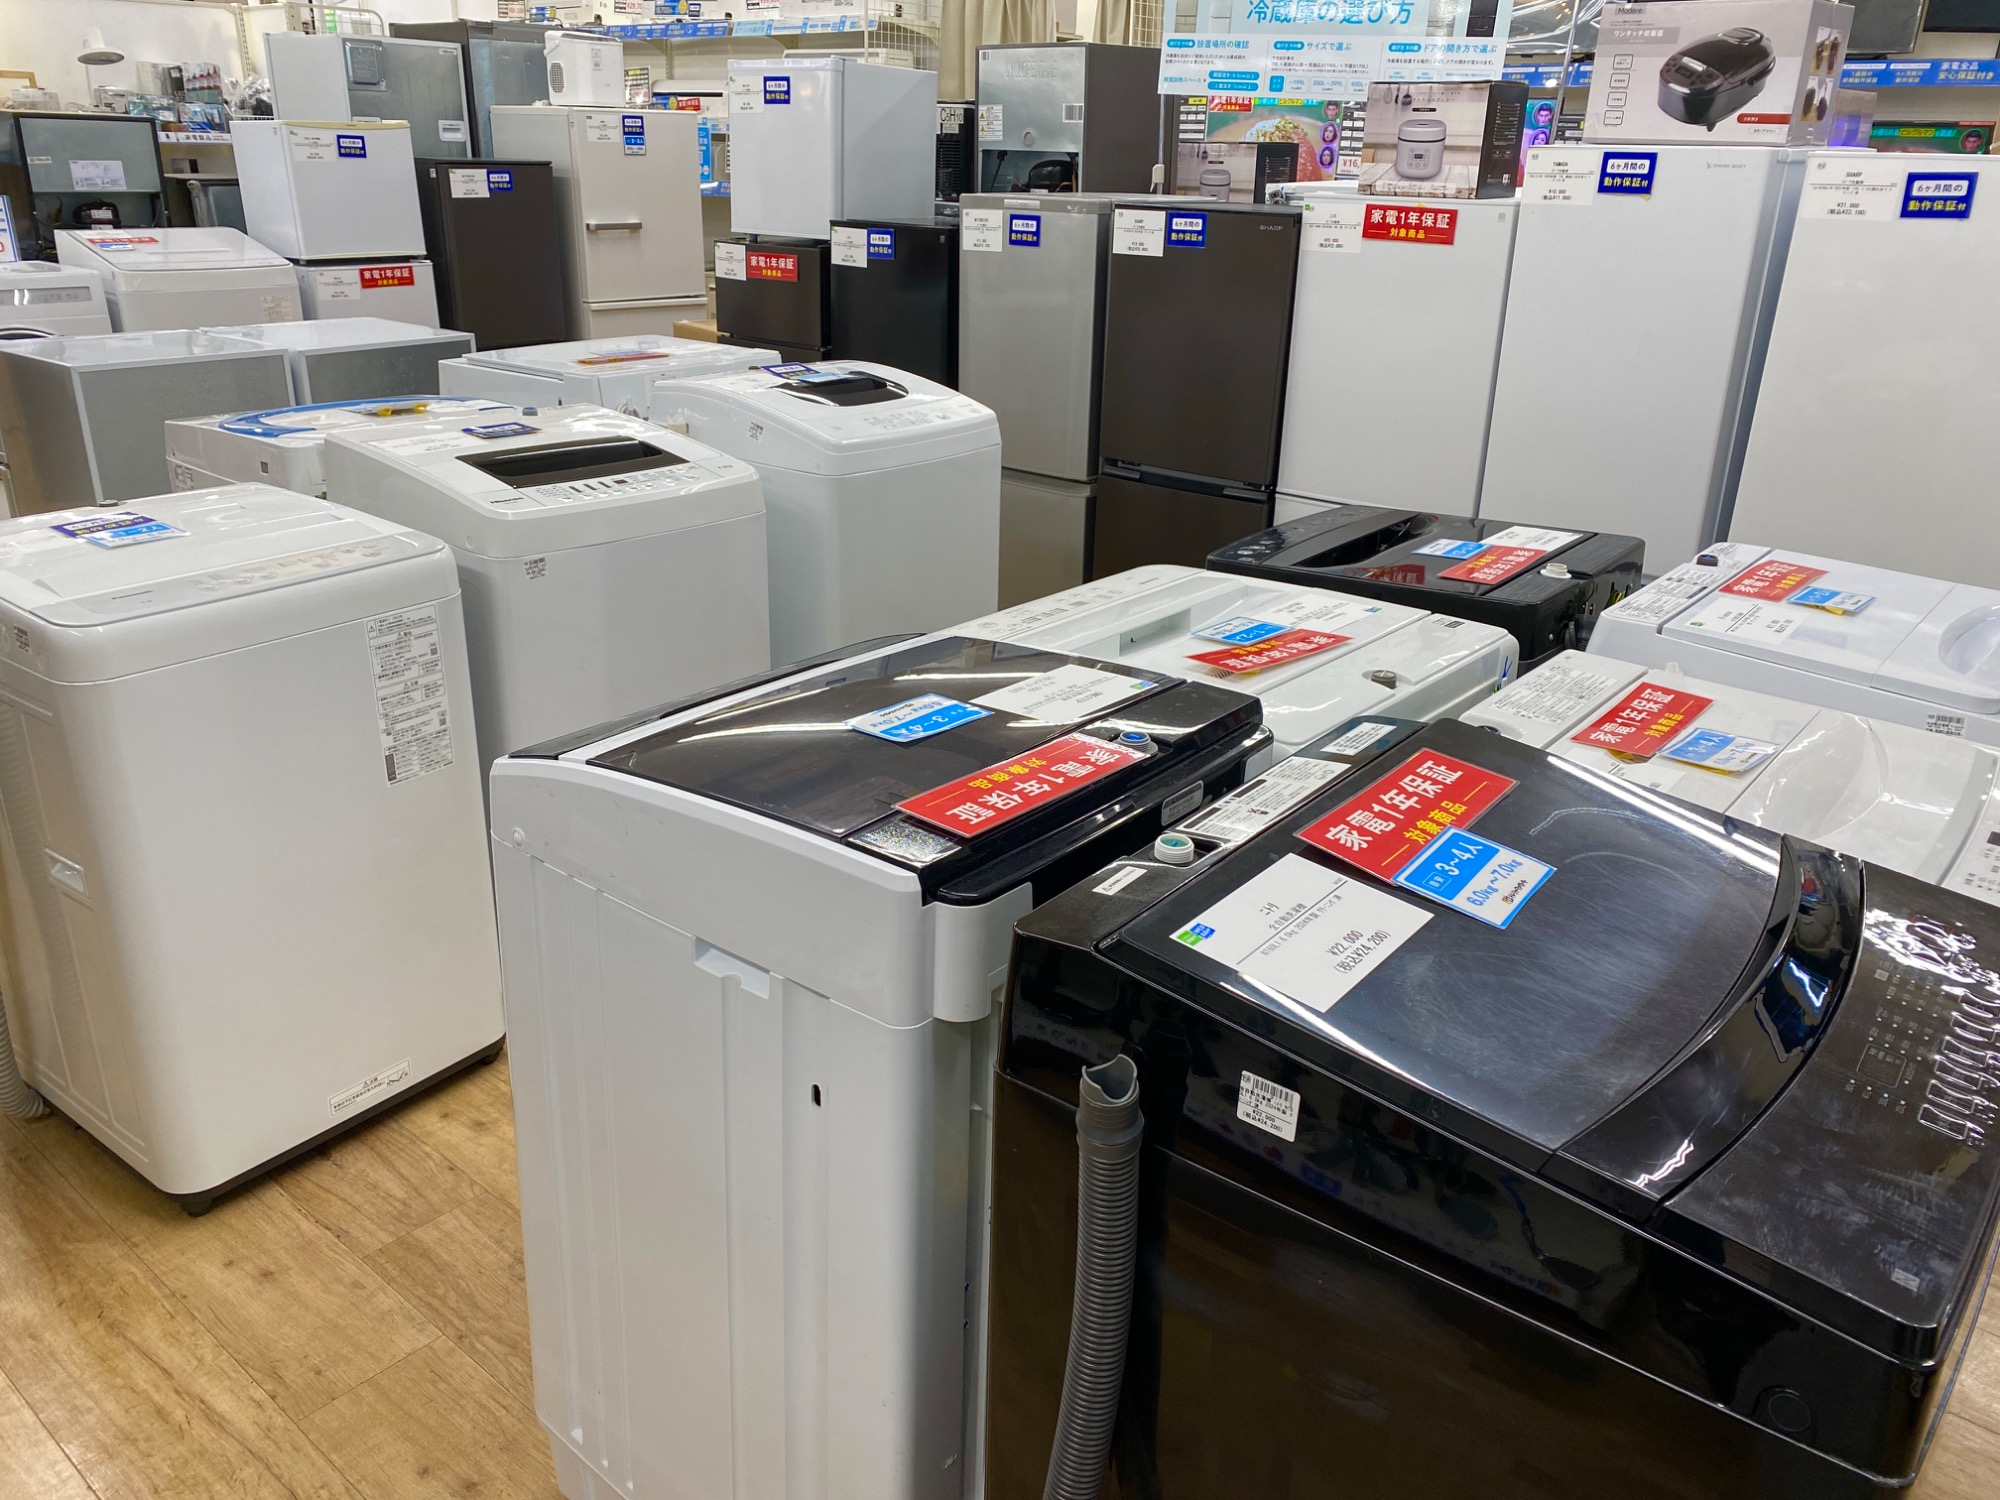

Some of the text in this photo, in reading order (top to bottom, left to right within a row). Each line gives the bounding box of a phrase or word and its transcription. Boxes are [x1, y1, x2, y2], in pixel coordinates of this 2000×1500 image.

[1306, 42, 1352, 51] サイズで選ぶ
[1424, 44, 1498, 54] ドアの開き方で選ぶ
[1941, 61, 1979, 70] 家電全品
[939, 108, 963, 123] C5H10
[1610, 162, 1646, 171] 6ヶ月間の
[1917, 183, 1963, 193] 6ヶ月間の
[1370, 209, 1451, 229] 家電1年保証
[1389, 227, 1426, 239] 対象商品
[750, 255, 794, 270] 家電1年保証
[1589, 688, 1676, 744] 家電1年保証
[967, 755, 1048, 790] 対象商品
[945, 747, 1122, 826] 家電1年保証
[1325, 760, 1464, 852] 家電1年保証
[1403, 800, 1469, 845] 対象商品
[1435, 841, 1483, 877] 3～4人
[1325, 930, 1364, 958] ¥22,000
[1333, 930, 1391, 974] (税込¥24,200)
[1253, 1109, 1276, 1123] ¥22,000
